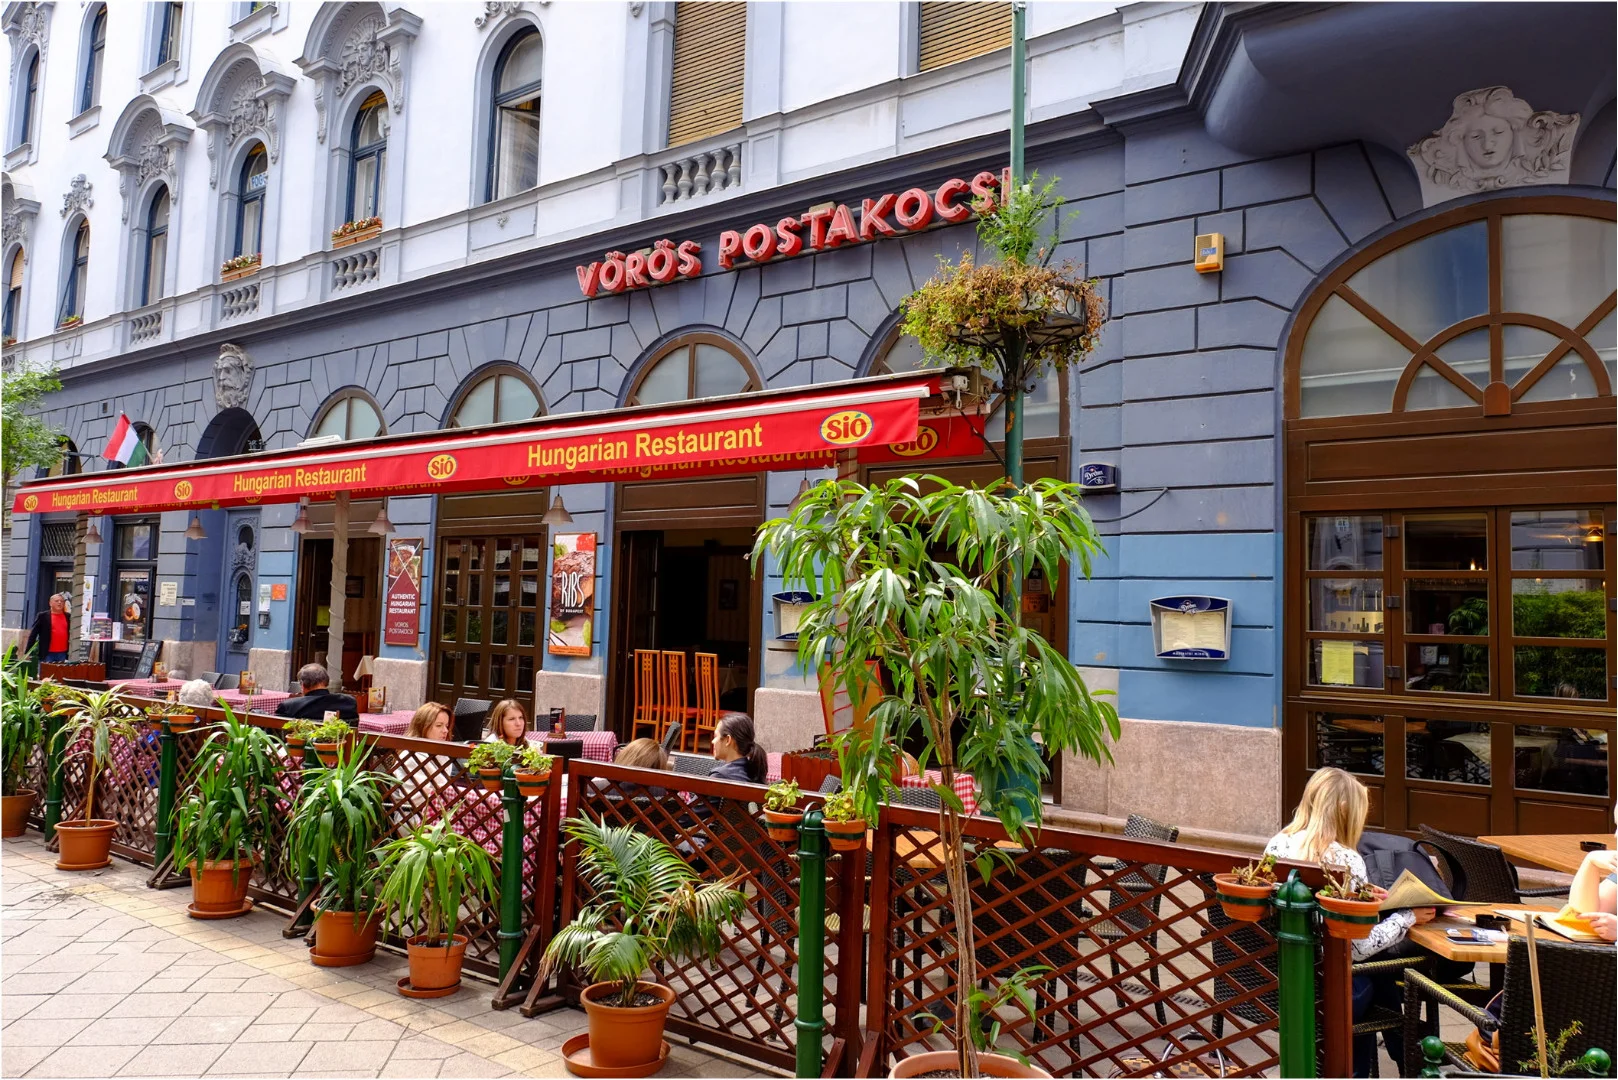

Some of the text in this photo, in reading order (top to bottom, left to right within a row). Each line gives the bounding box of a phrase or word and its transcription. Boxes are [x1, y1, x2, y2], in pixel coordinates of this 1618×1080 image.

[576, 166, 1011, 298] VÖRÖS POSTAKOCSI
[527, 437, 628, 470] Hungarian
[635, 421, 763, 458] Restaurant
[233, 462, 367, 495] Hungarian Restaurant
[52, 486, 138, 510] Hungarian Restaurant
[561, 571, 585, 608] RIBS
